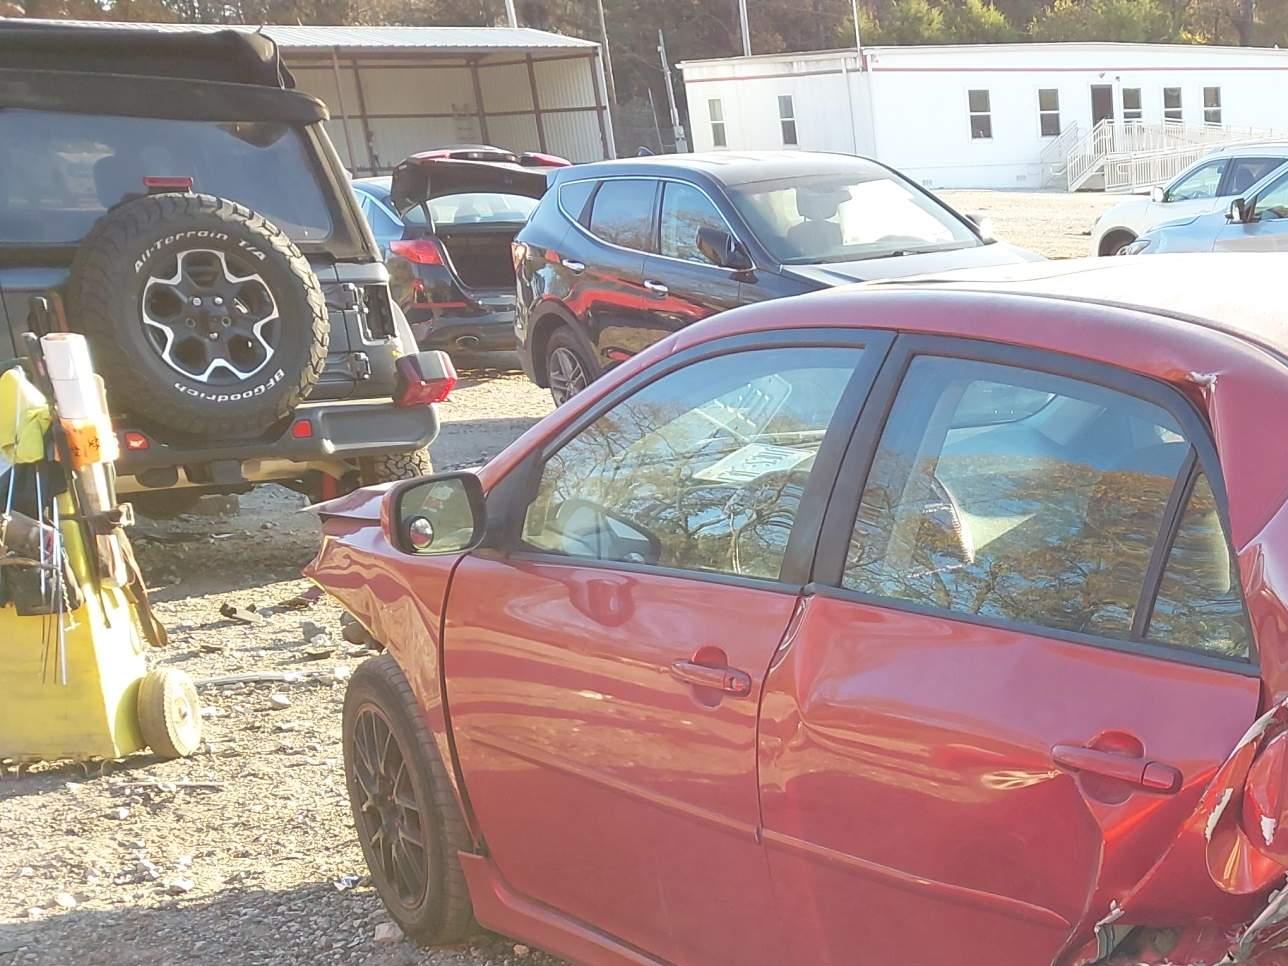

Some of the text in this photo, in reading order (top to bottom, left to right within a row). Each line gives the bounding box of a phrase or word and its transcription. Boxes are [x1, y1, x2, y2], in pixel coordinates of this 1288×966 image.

[133, 229, 268, 273] All-Terrain T/A
[174, 367, 286, 403] BFGoodrich
